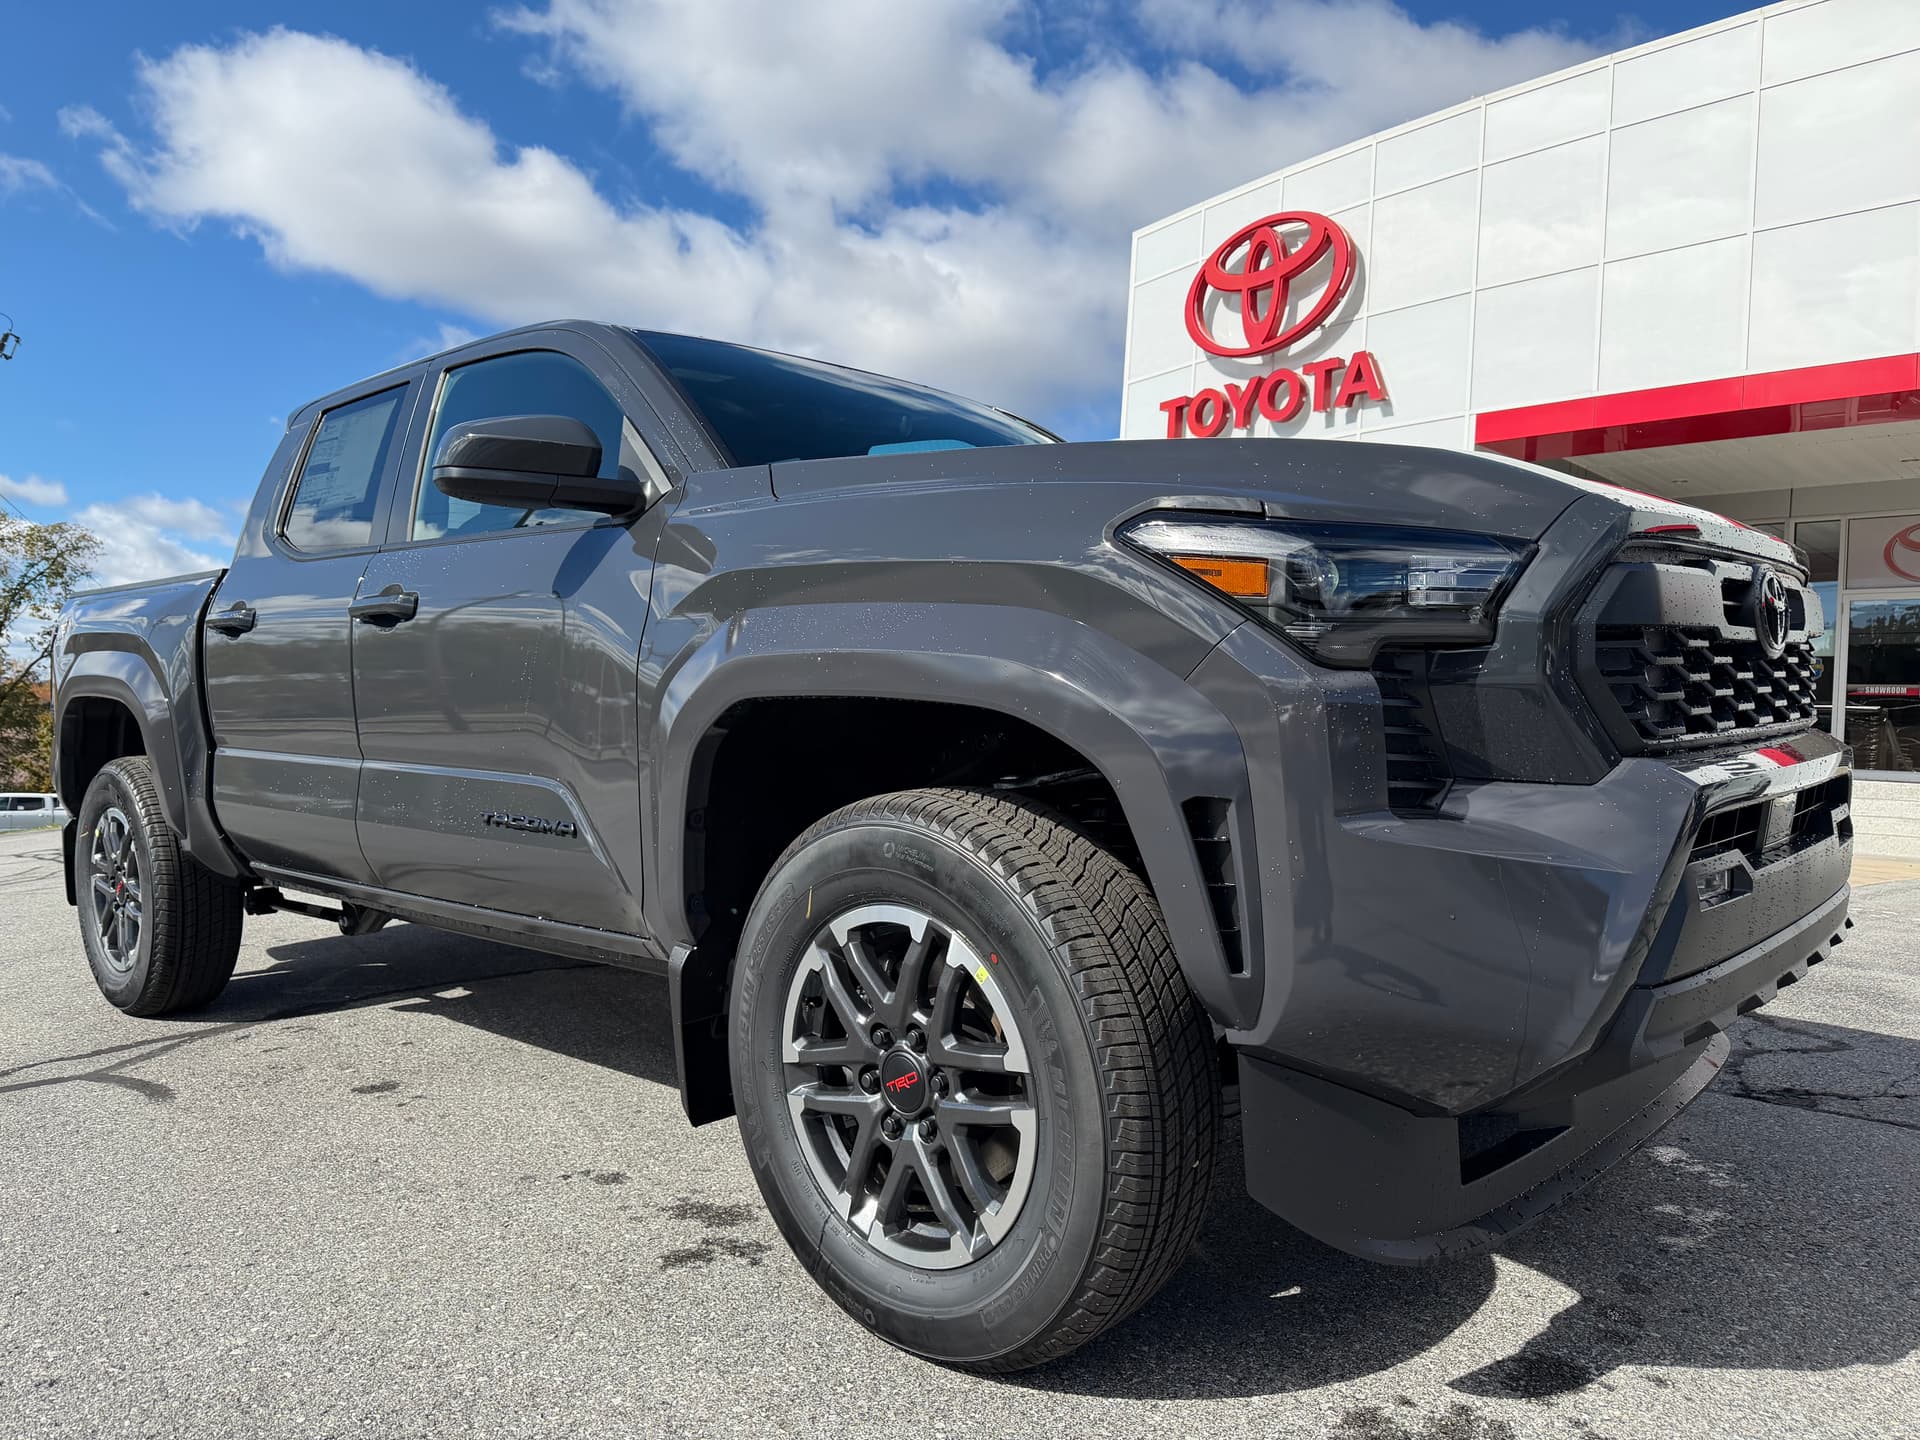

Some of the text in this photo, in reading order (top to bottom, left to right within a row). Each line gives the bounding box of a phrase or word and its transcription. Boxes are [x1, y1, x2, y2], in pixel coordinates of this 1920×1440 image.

[1160, 351, 1387, 439] TOYOTA
[1865, 686, 1907, 694] SHOWROOM
[480, 810, 578, 838] TACOMA
[886, 1071, 919, 1093] TRD
[1049, 1066, 1074, 1229] MICHELIN
